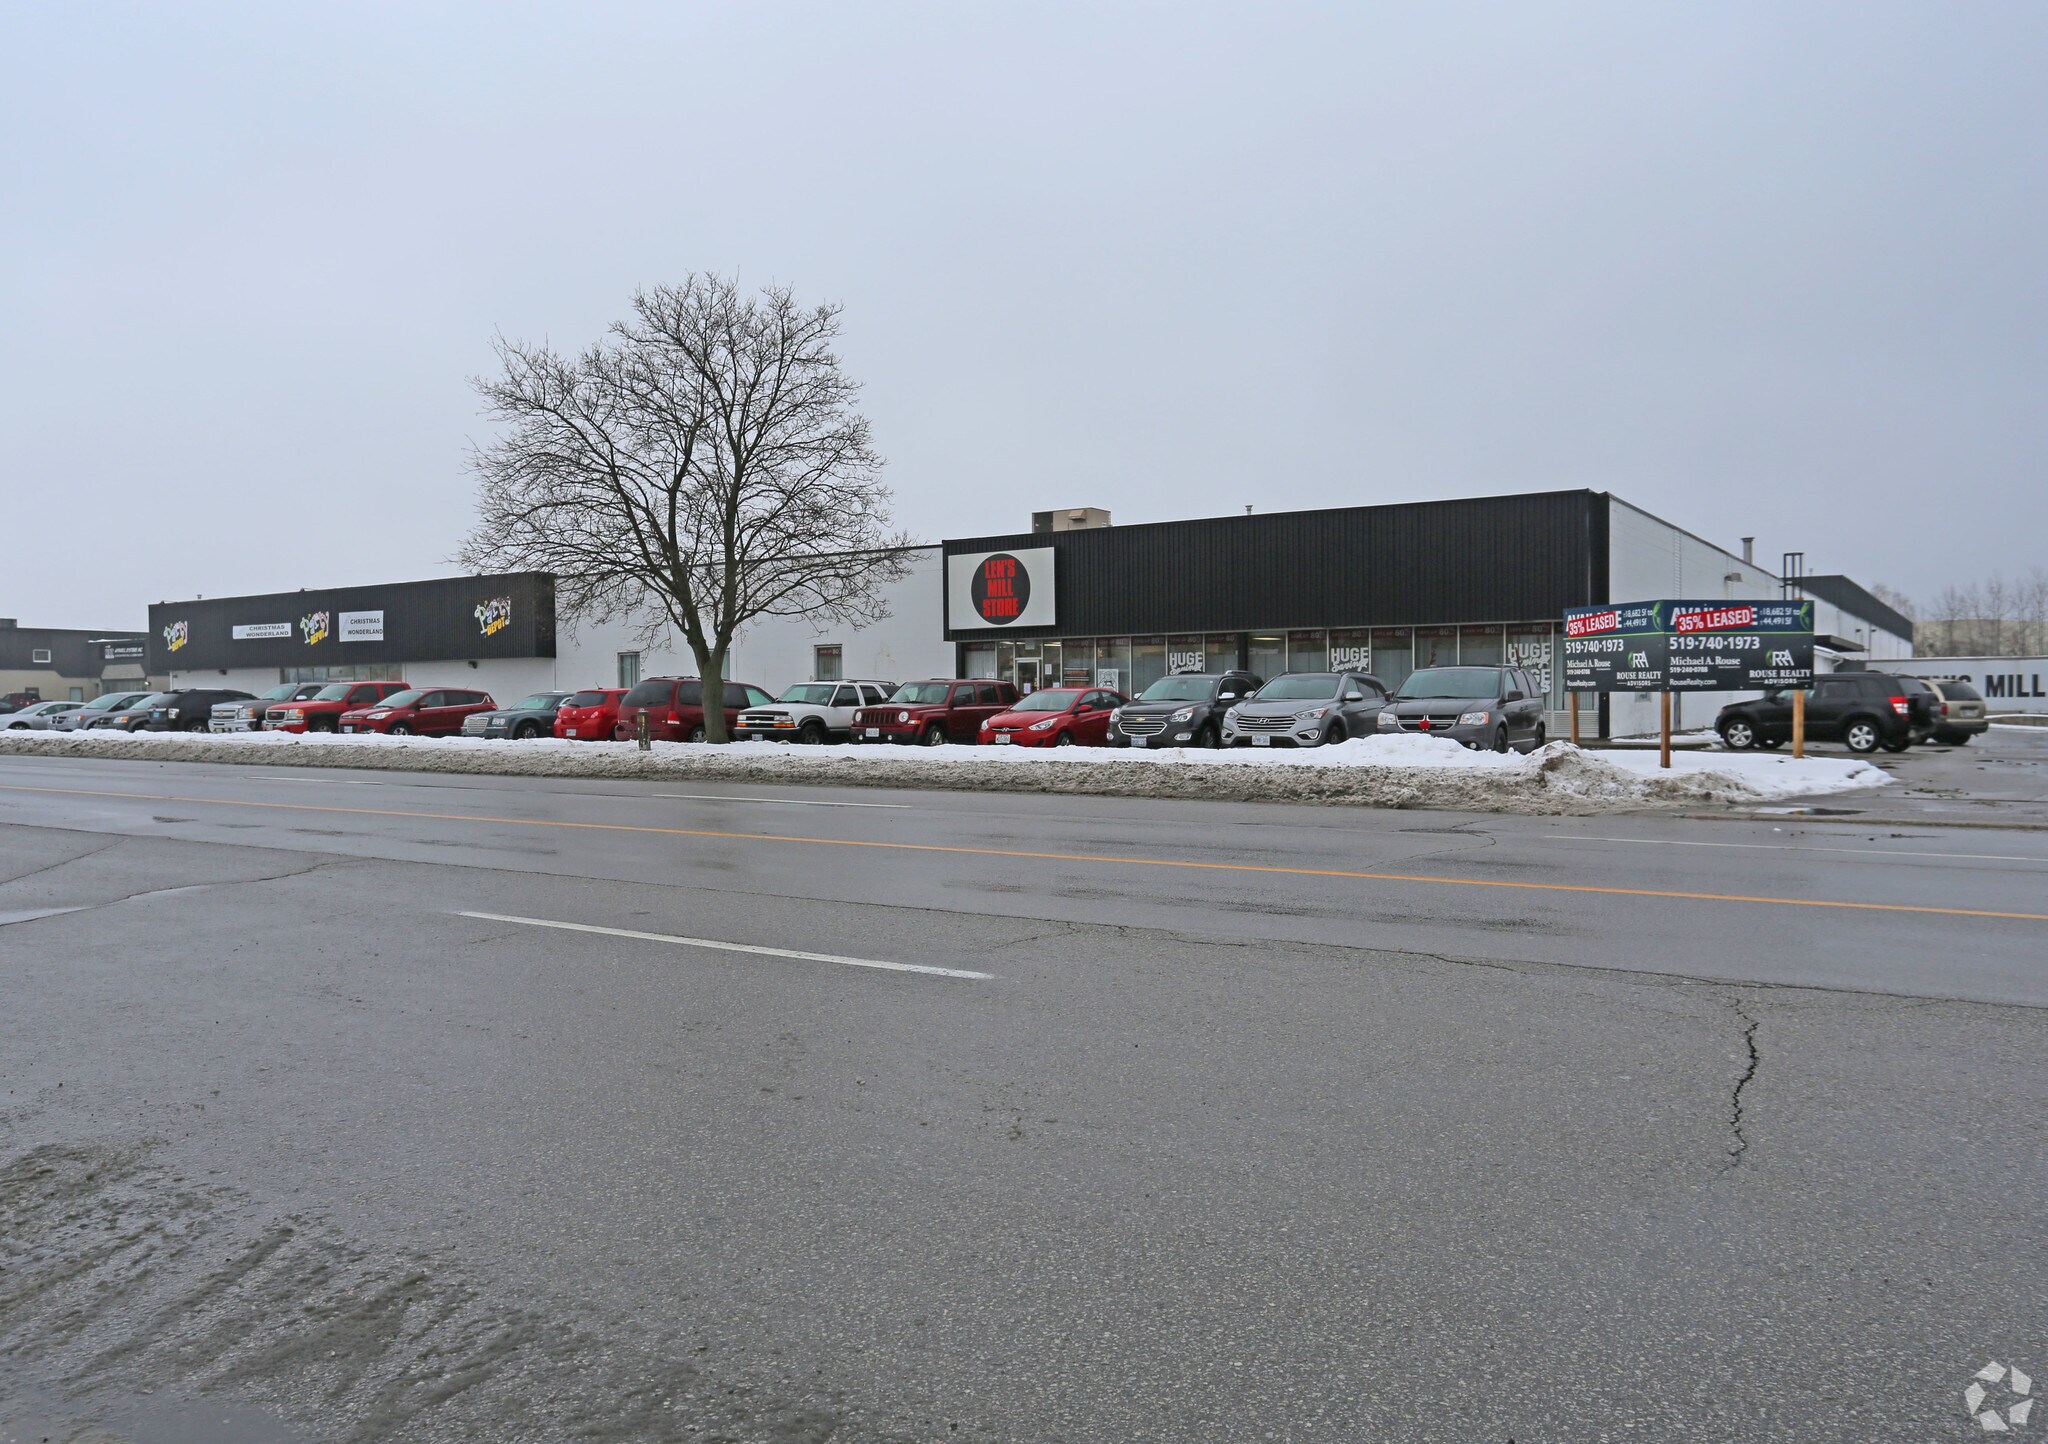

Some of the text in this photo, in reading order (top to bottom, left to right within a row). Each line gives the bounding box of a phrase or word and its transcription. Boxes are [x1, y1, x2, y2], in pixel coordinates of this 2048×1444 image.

[985, 559, 1016, 578] LEN'S
[987, 578, 1013, 597] MILL
[983, 597, 1018, 617] STORE
[1569, 620, 1585, 635] 35%
[1586, 614, 1614, 632] LEASED
[1680, 615, 1704, 631] 35%
[1706, 609, 1751, 628] LEASED
[1331, 647, 1368, 662] HUGE
[1508, 643, 1550, 658] HUGE
[1169, 652, 1202, 666] HUGE
[1331, 658, 1368, 672] Savings
[1567, 660, 1587, 668] Michael
[1594, 659, 1611, 667] Rouse
[1670, 656, 1740, 665] Michael A. Rouse
[1617, 671, 1662, 680] ROUSE REALTY
[1749, 669, 1811, 678] ROUSE REALTY
[1669, 679, 1717, 687] RouseRealty.com
[1985, 674, 2045, 698] MILL
